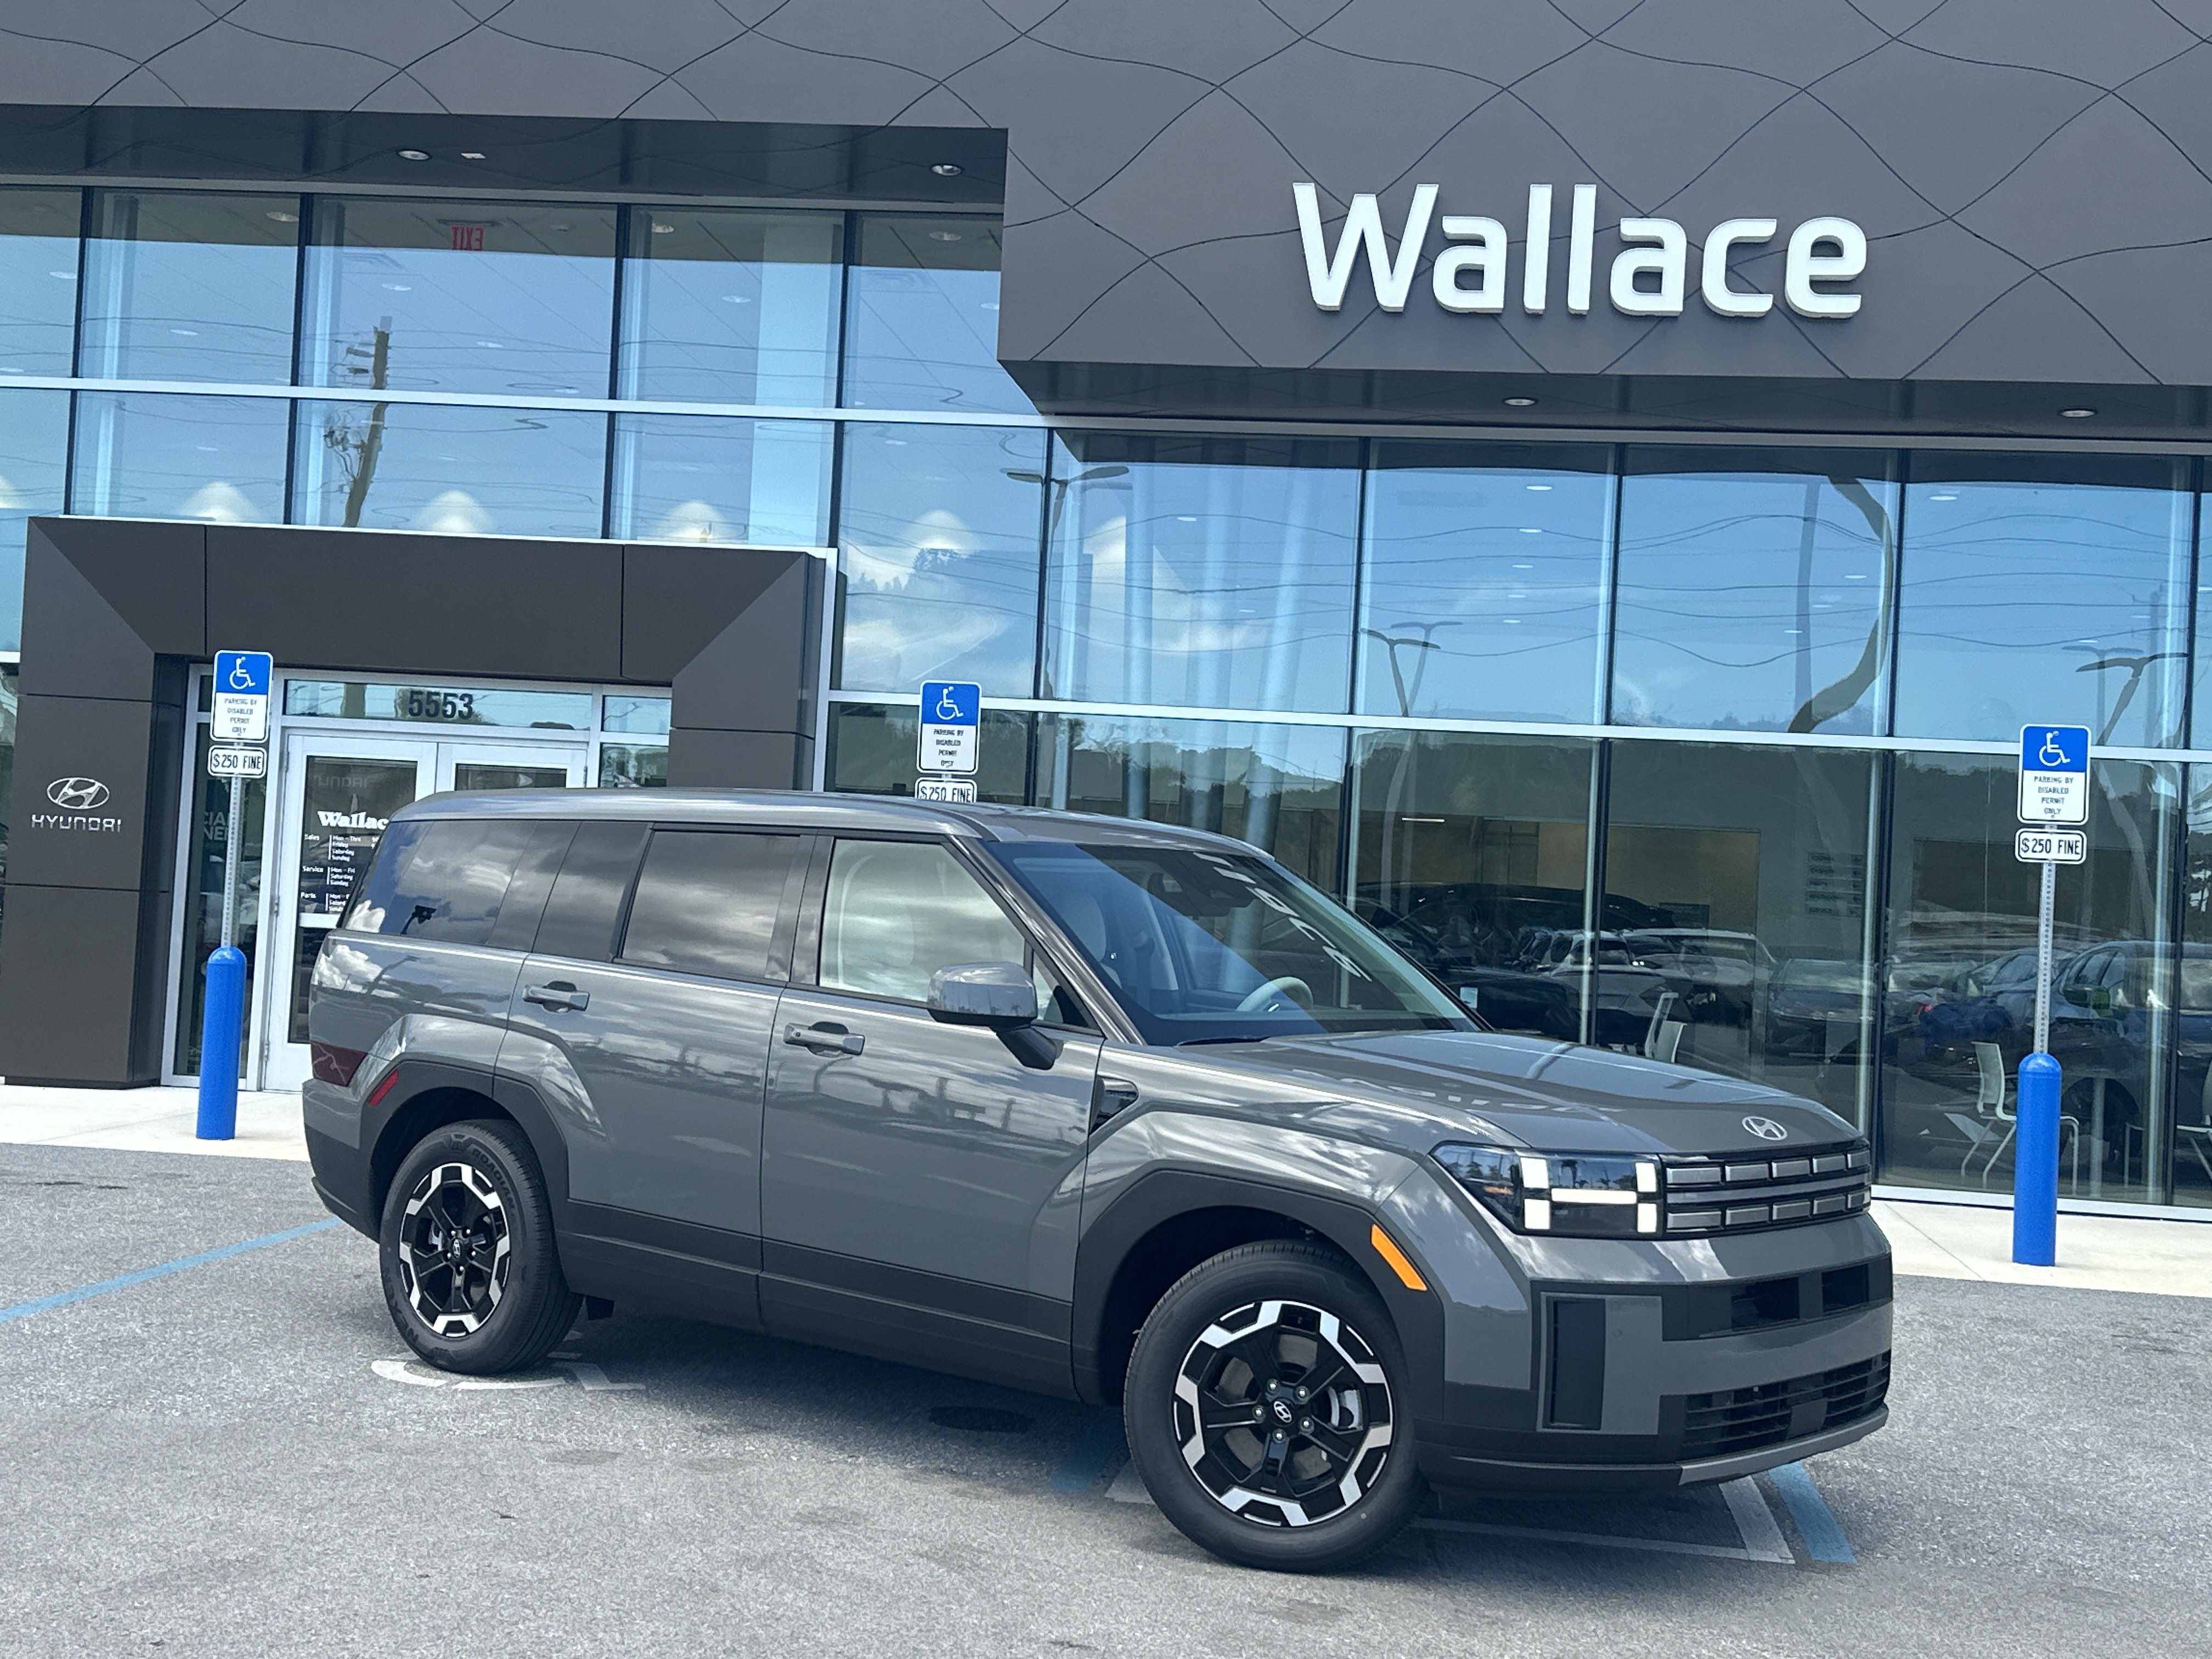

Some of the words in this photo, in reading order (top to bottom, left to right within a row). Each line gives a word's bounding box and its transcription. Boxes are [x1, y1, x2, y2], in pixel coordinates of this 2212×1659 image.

[1293, 182, 1867, 318] Wallace
[408, 691, 473, 720] 5553
[213, 753, 238, 769] $250
[242, 755, 262, 769] FINE
[920, 786, 947, 800] $250
[952, 787, 972, 803] FINE
[31, 814, 121, 832] HYUNDAI
[317, 811, 390, 830] Wallac
[2021, 837, 2052, 853] $250
[2058, 839, 2080, 855] FINE
